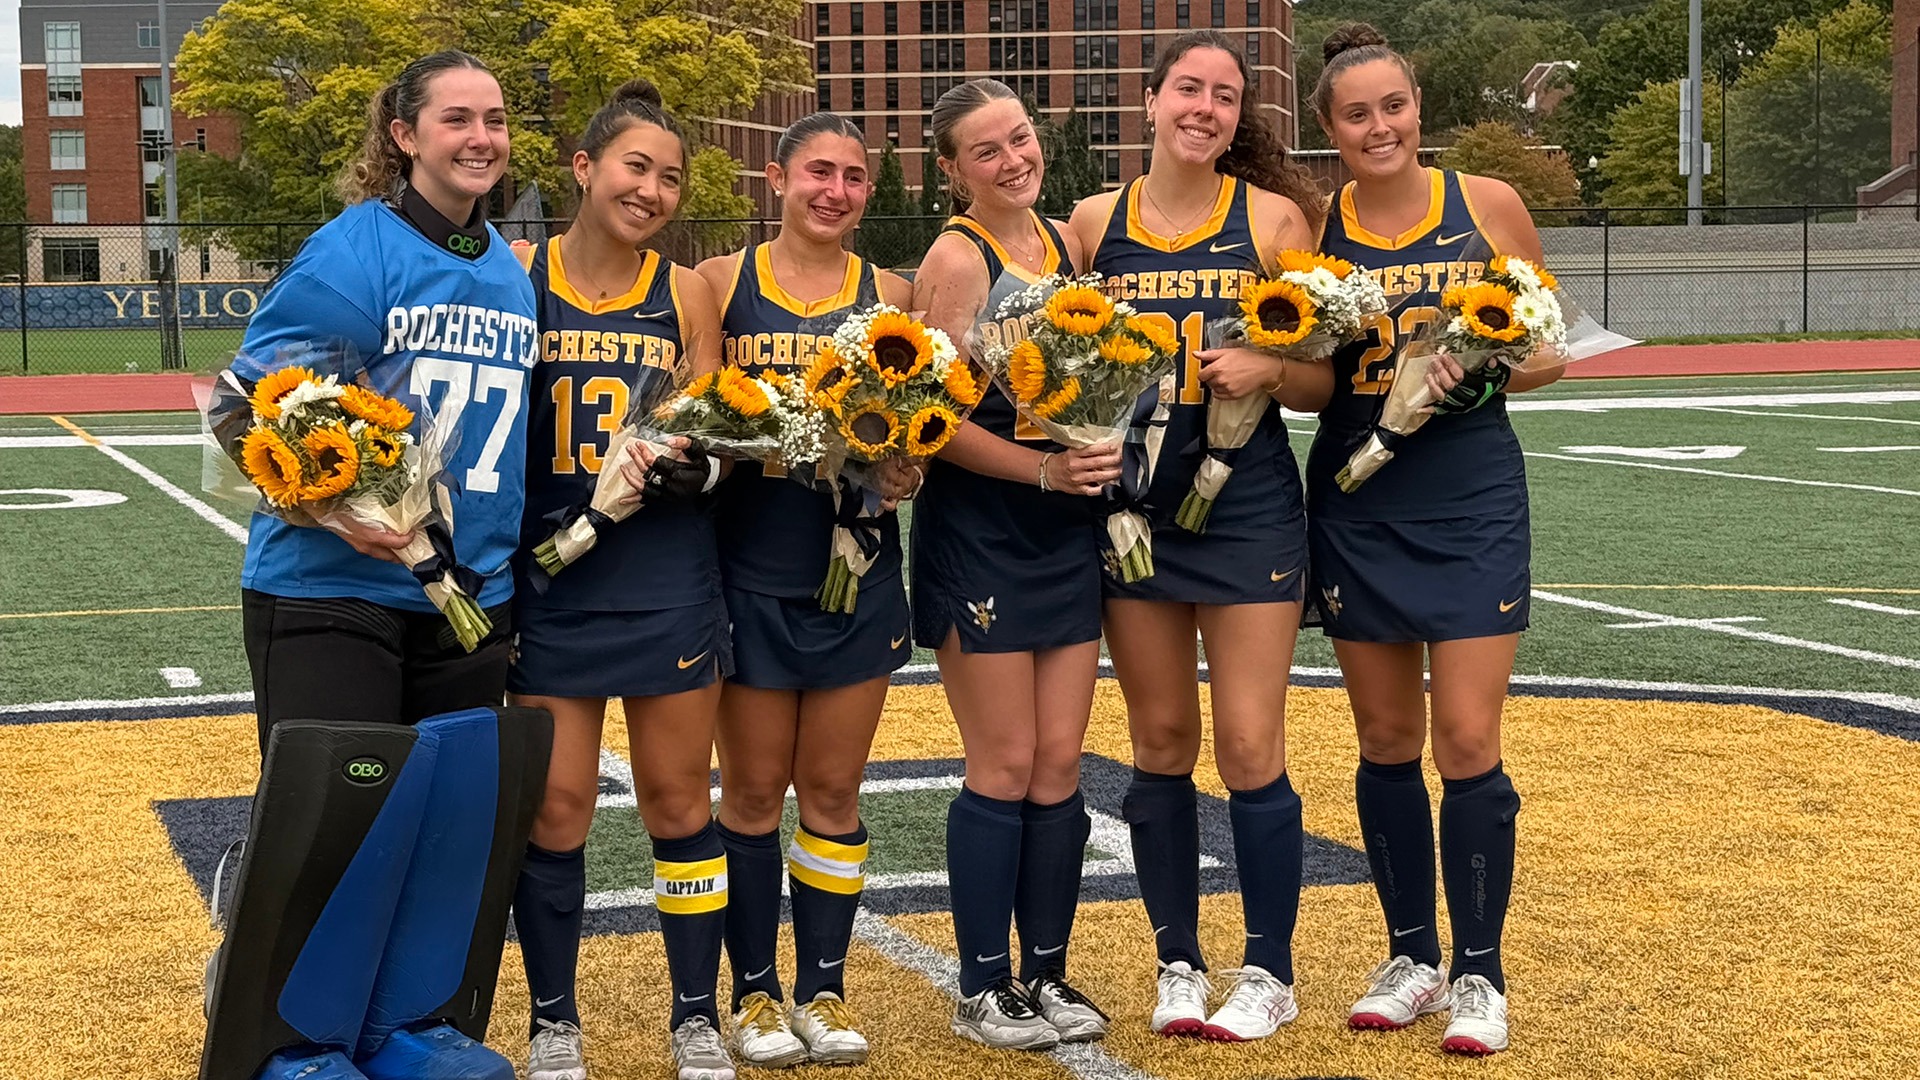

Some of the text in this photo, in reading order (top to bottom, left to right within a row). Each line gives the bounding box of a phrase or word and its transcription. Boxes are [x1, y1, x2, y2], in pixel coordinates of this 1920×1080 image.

[448, 234, 481, 255] OBO
[1101, 269, 1258, 301] OCHESTER
[1368, 262, 1486, 296] ESTER
[103, 288, 259, 319] YELO
[540, 330, 676, 373] CHESTER
[410, 356, 525, 493] 77
[551, 376, 630, 474] 13
[349, 763, 383, 777] OBO
[666, 877, 716, 895] CAPTAIN
